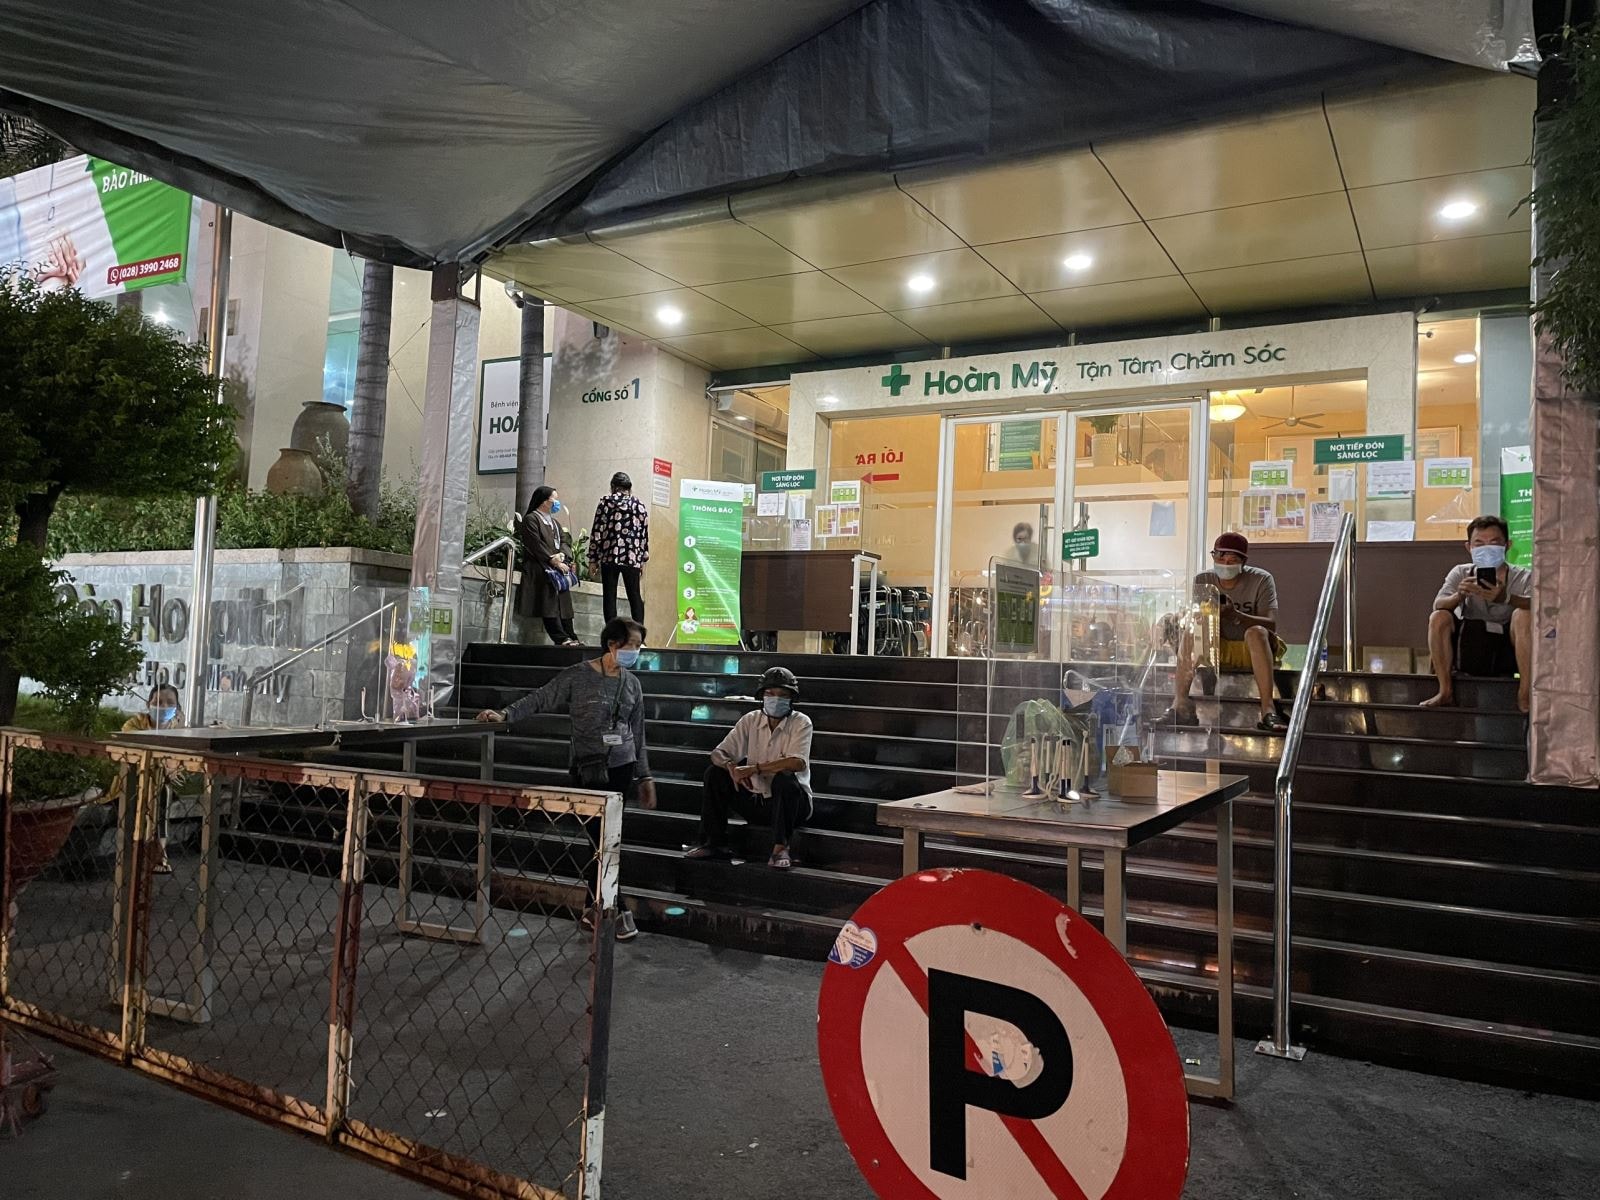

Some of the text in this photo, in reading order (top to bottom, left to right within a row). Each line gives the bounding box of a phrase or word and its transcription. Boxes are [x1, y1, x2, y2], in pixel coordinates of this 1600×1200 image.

[102, 168, 128, 193] BẢO
[119, 257, 179, 279] (028) 3990 2468
[924, 343, 1286, 396] Hoàn Mỹ Tận Tâm Chăm Sóc
[582, 377, 640, 403] CỔNG SỐ 1
[1329, 441, 1385, 452] NƠI TIẾP ĐÓN
[1337, 450, 1378, 460] SÀNG LỌC
[927, 967, 1074, 1181] P
